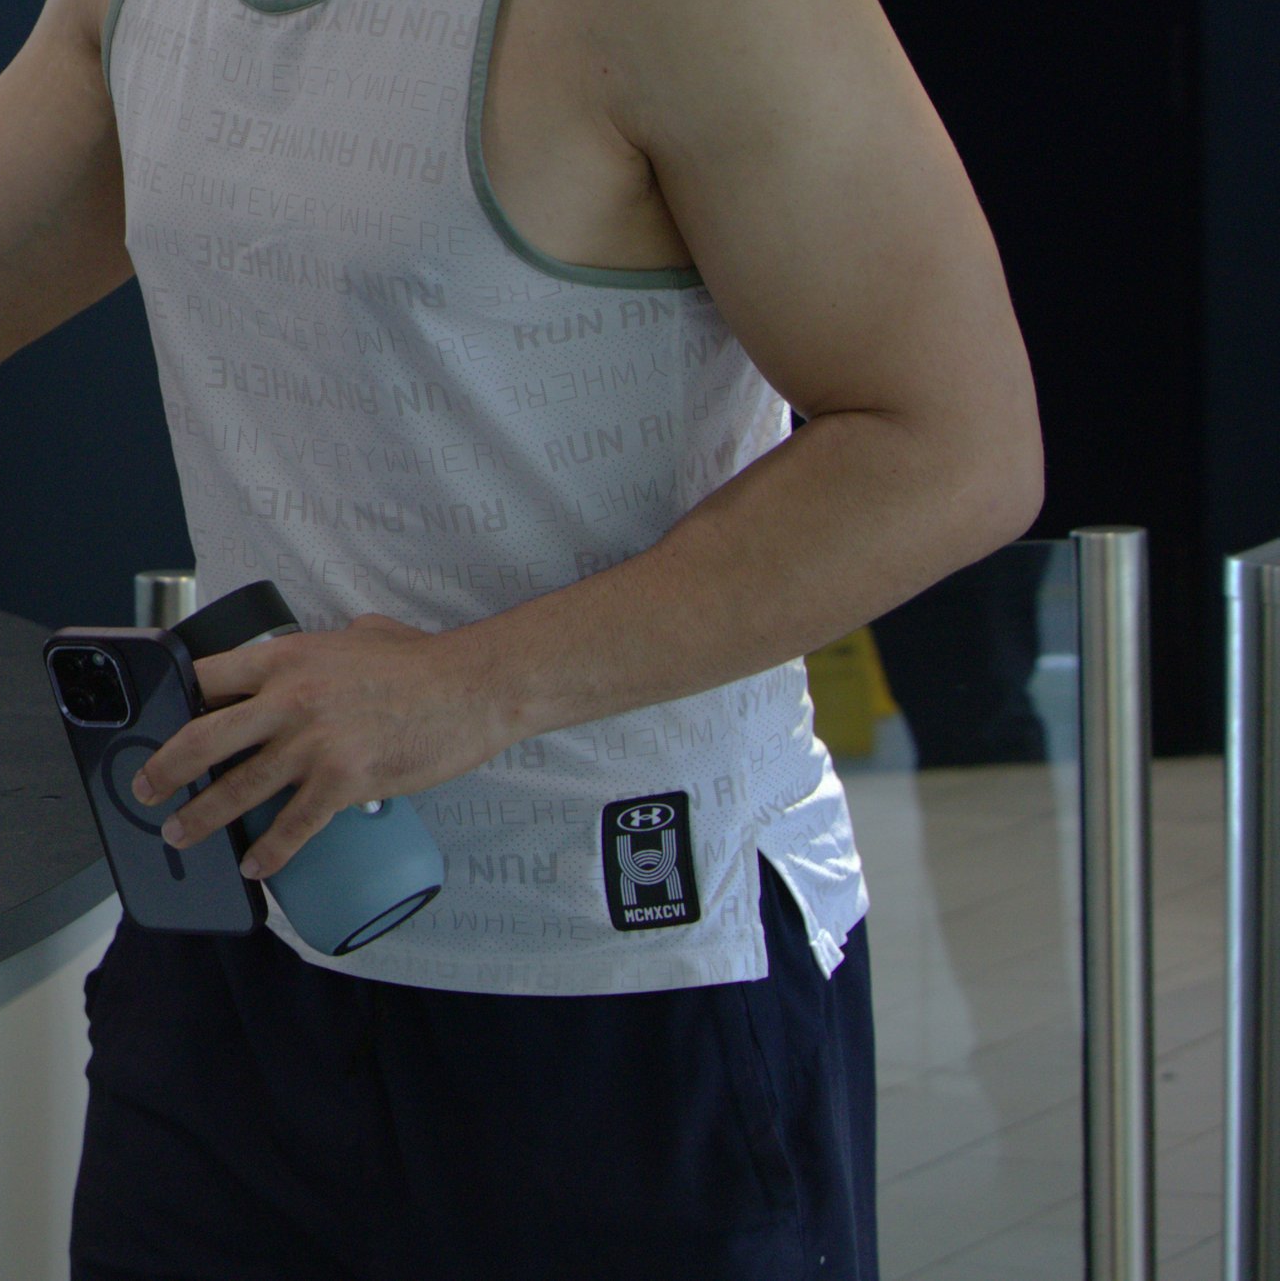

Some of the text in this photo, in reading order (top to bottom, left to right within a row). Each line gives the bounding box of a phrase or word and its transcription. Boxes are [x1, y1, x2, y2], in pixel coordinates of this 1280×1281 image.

[203, 108, 360, 170] ANYWHERE
[366, 128, 449, 186] RUN
[180, 171, 238, 210] RUN
[246, 186, 475, 256] EVERYWHERE
[512, 309, 603, 351] RUN
[204, 354, 382, 417] ANYWHERE
[544, 424, 624, 471] RUN
[418, 497, 507, 535] RUN
[468, 850, 559, 887] RUN
[624, 904, 686, 922] MCMXCVI
